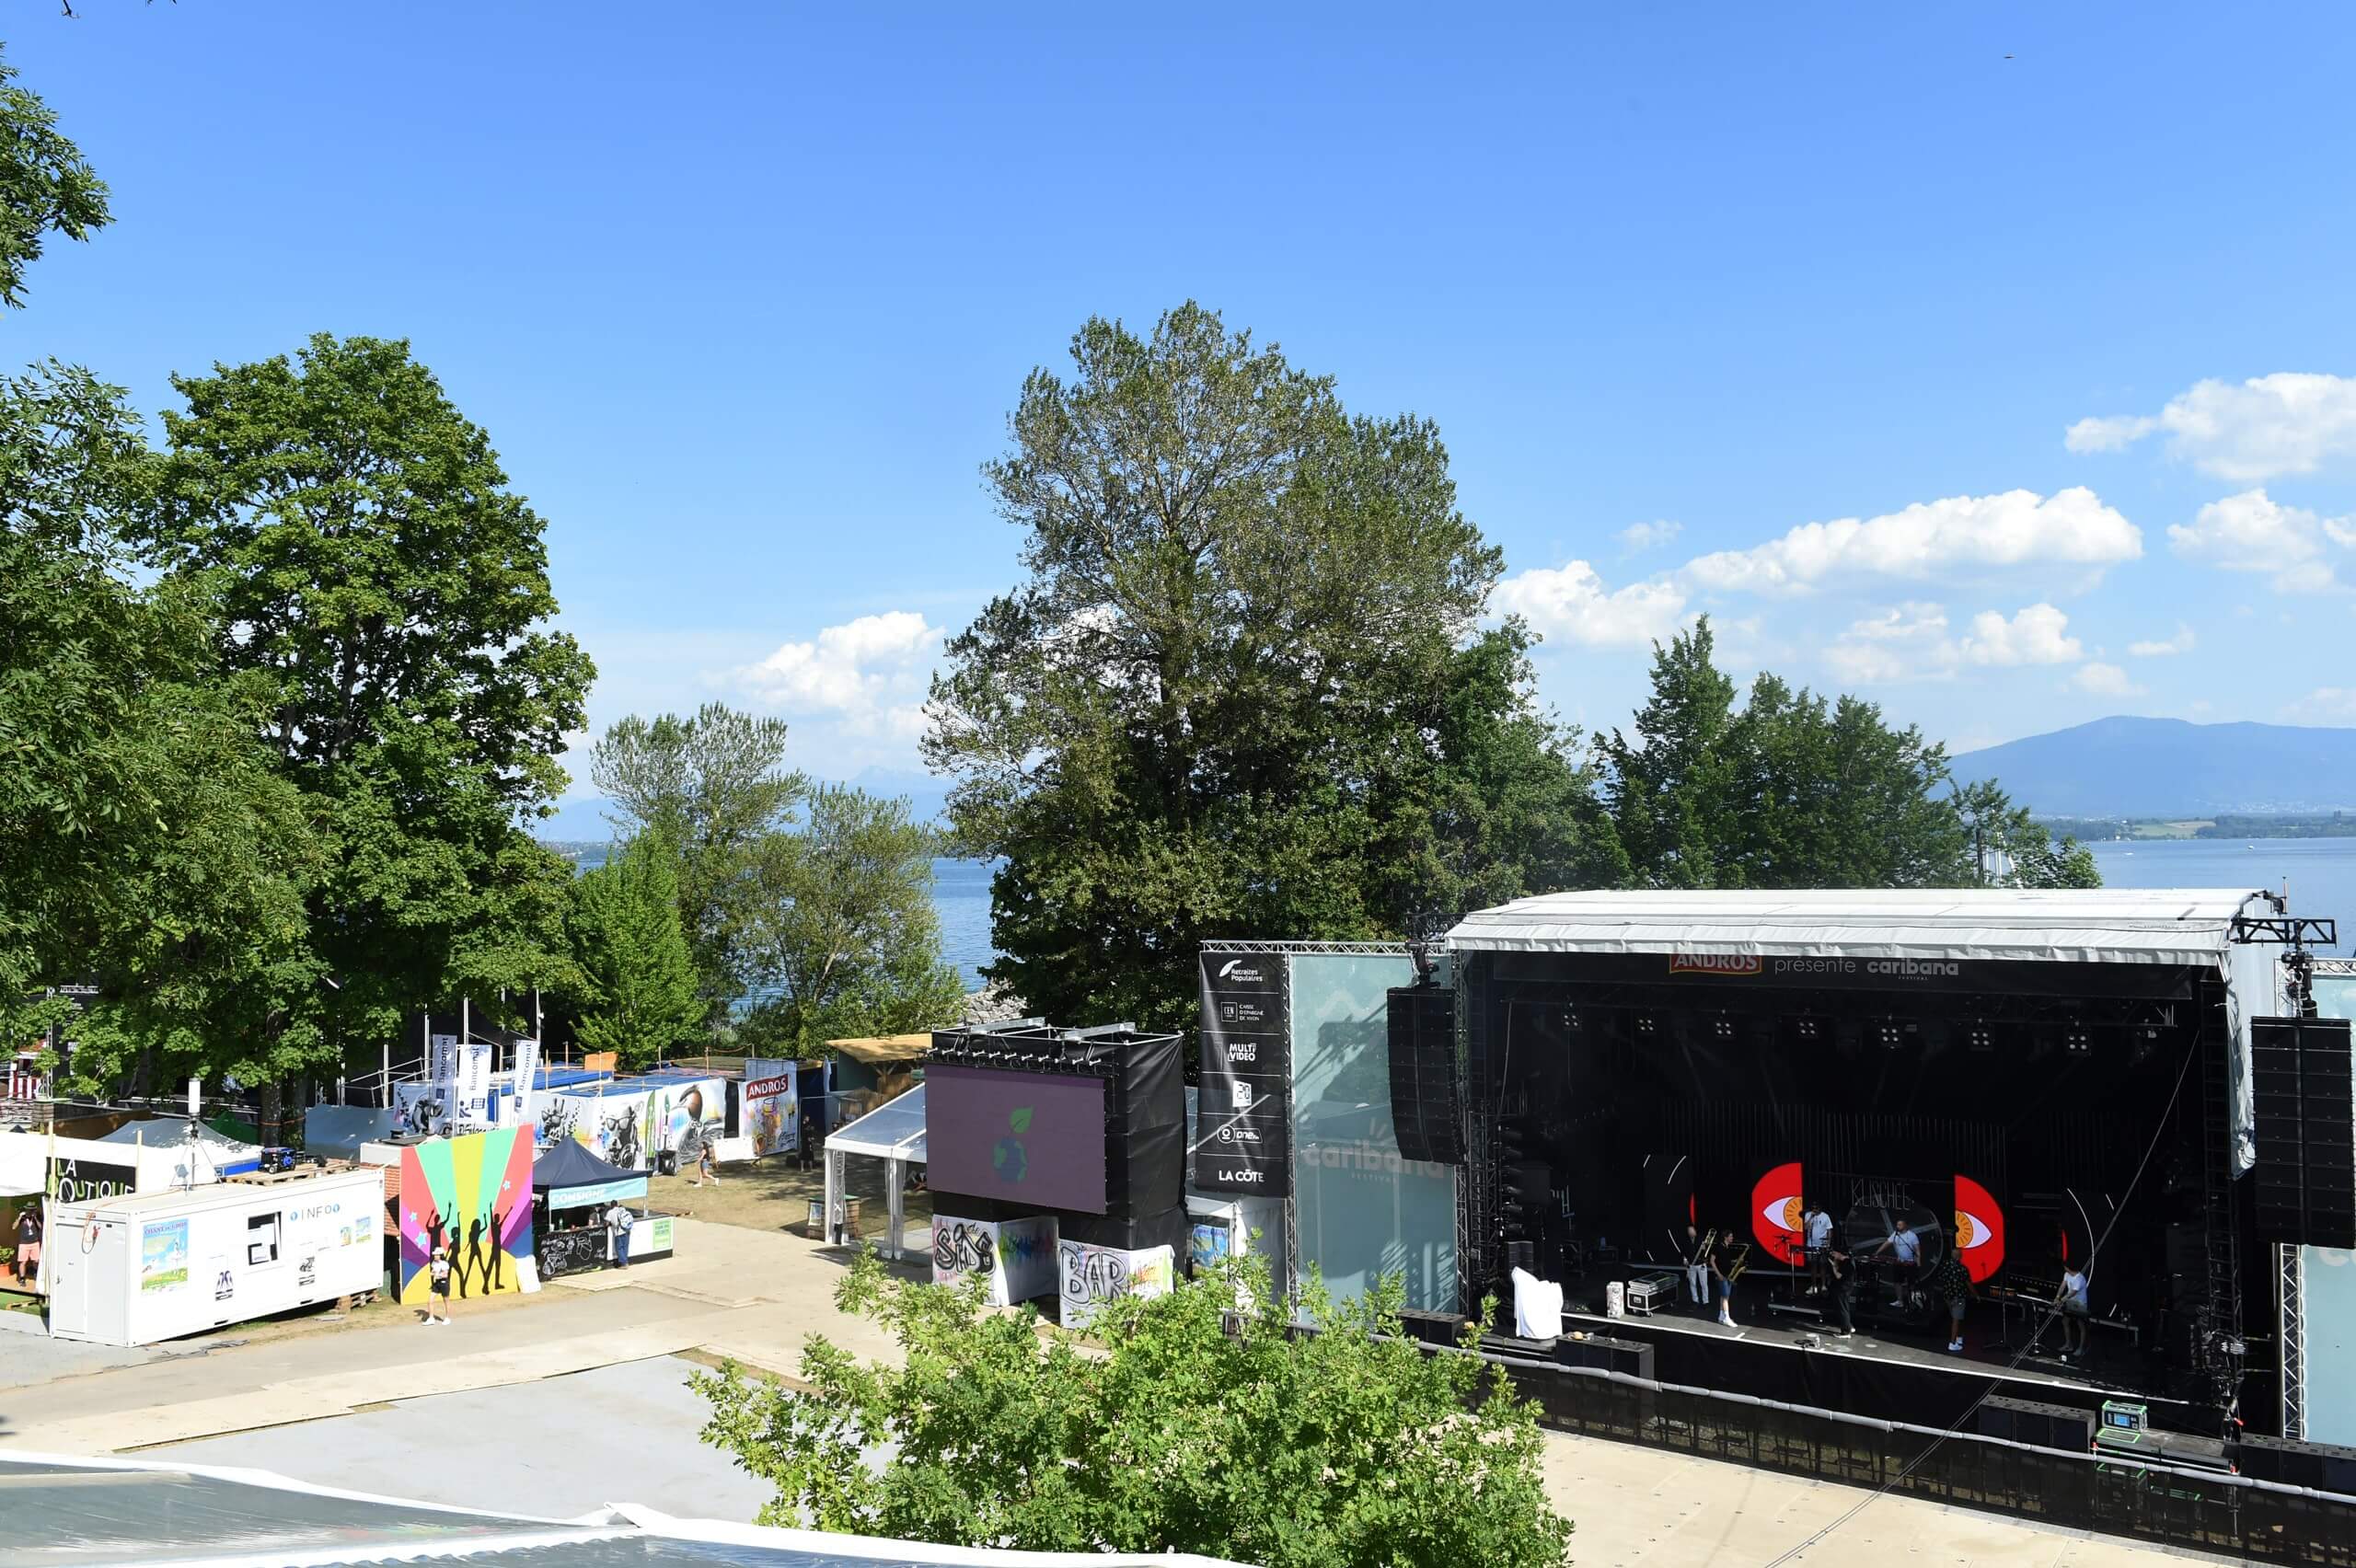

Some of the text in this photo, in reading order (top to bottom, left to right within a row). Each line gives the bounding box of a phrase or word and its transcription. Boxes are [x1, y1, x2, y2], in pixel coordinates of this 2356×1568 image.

[1674, 954, 1959, 975] ANDROS présente caribana
[1229, 1052, 1256, 1061] VIDEO
[1230, 1043, 1255, 1053] MULTI
[438, 1037, 449, 1083] Bancomat
[470, 1047, 479, 1091] Bancomat
[517, 1043, 532, 1091] Bancomat
[748, 1078, 787, 1098] ANDROS
[57, 1159, 77, 1177] LA
[1302, 1139, 1444, 1179] caribana
[1218, 1170, 1234, 1182] LA
[301, 1205, 332, 1219] INFO
[1062, 1247, 1126, 1305] BAR
